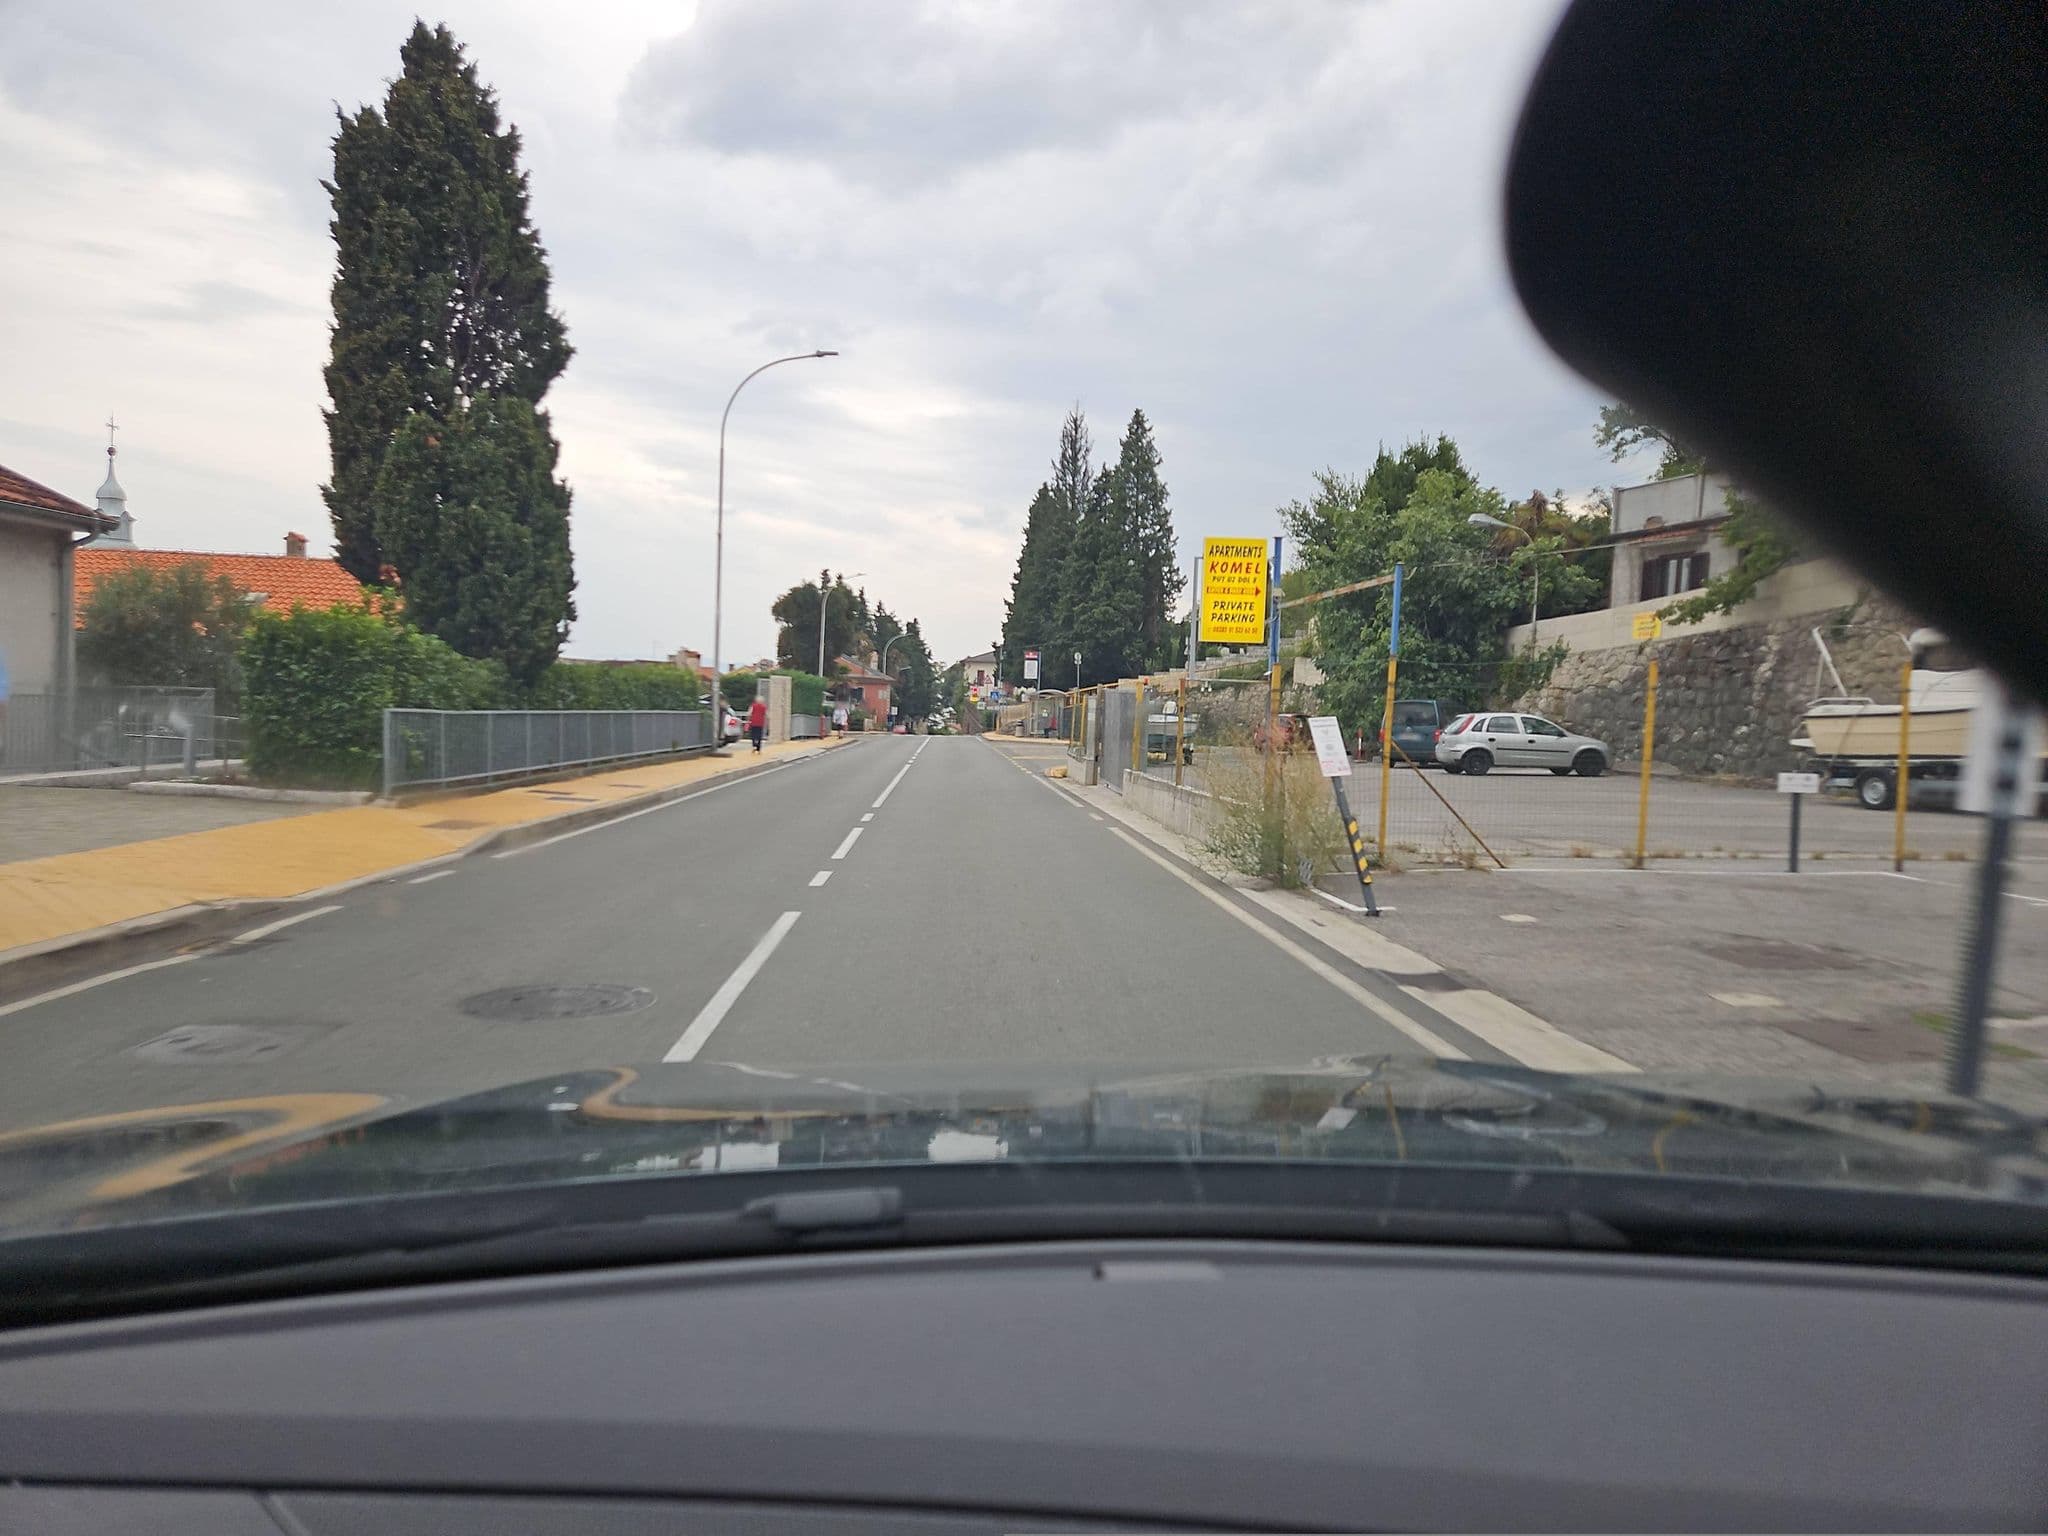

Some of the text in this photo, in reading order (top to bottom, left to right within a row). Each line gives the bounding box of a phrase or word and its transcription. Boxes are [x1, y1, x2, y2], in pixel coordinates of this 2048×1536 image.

[1209, 545, 1263, 558] APARTMENTS
[1209, 561, 1262, 575] KOMEL
[1213, 600, 1255, 611] PRIVATE
[1211, 612, 1256, 623] PARKING
